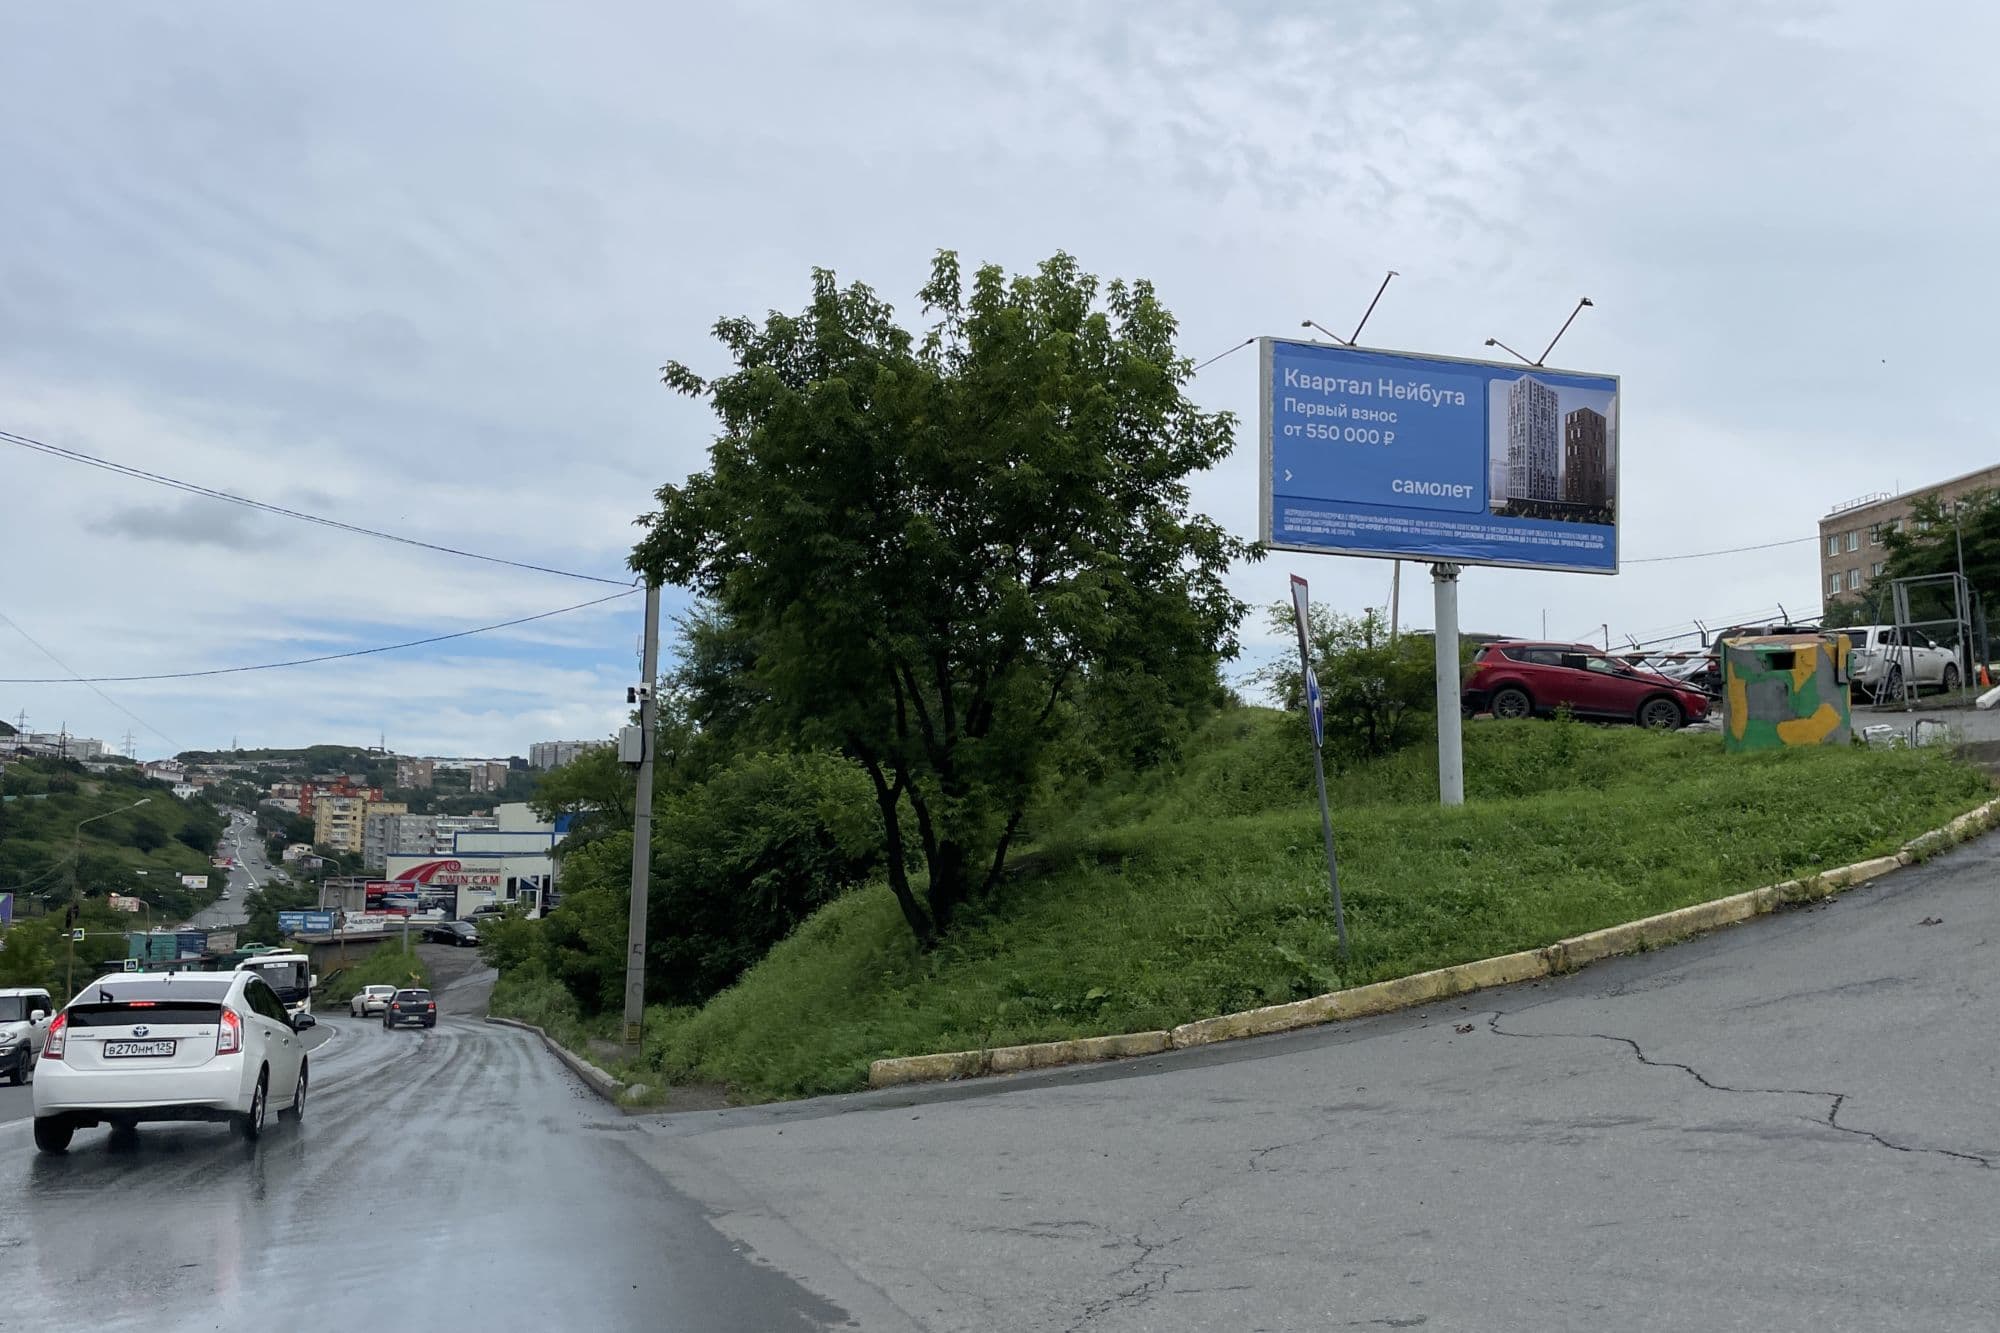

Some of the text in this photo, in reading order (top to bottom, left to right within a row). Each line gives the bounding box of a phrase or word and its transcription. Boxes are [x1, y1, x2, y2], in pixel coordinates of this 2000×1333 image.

[1284, 367, 1465, 407] Квартал Нейбута
[1284, 397, 1398, 424] Первый взнос
[1283, 424, 1302, 437] от
[1306, 423, 1340, 440] 550
[1344, 427, 1380, 445] 000
[1391, 478, 1473, 499] самолет
[438, 874, 500, 886] TWIN CAM
